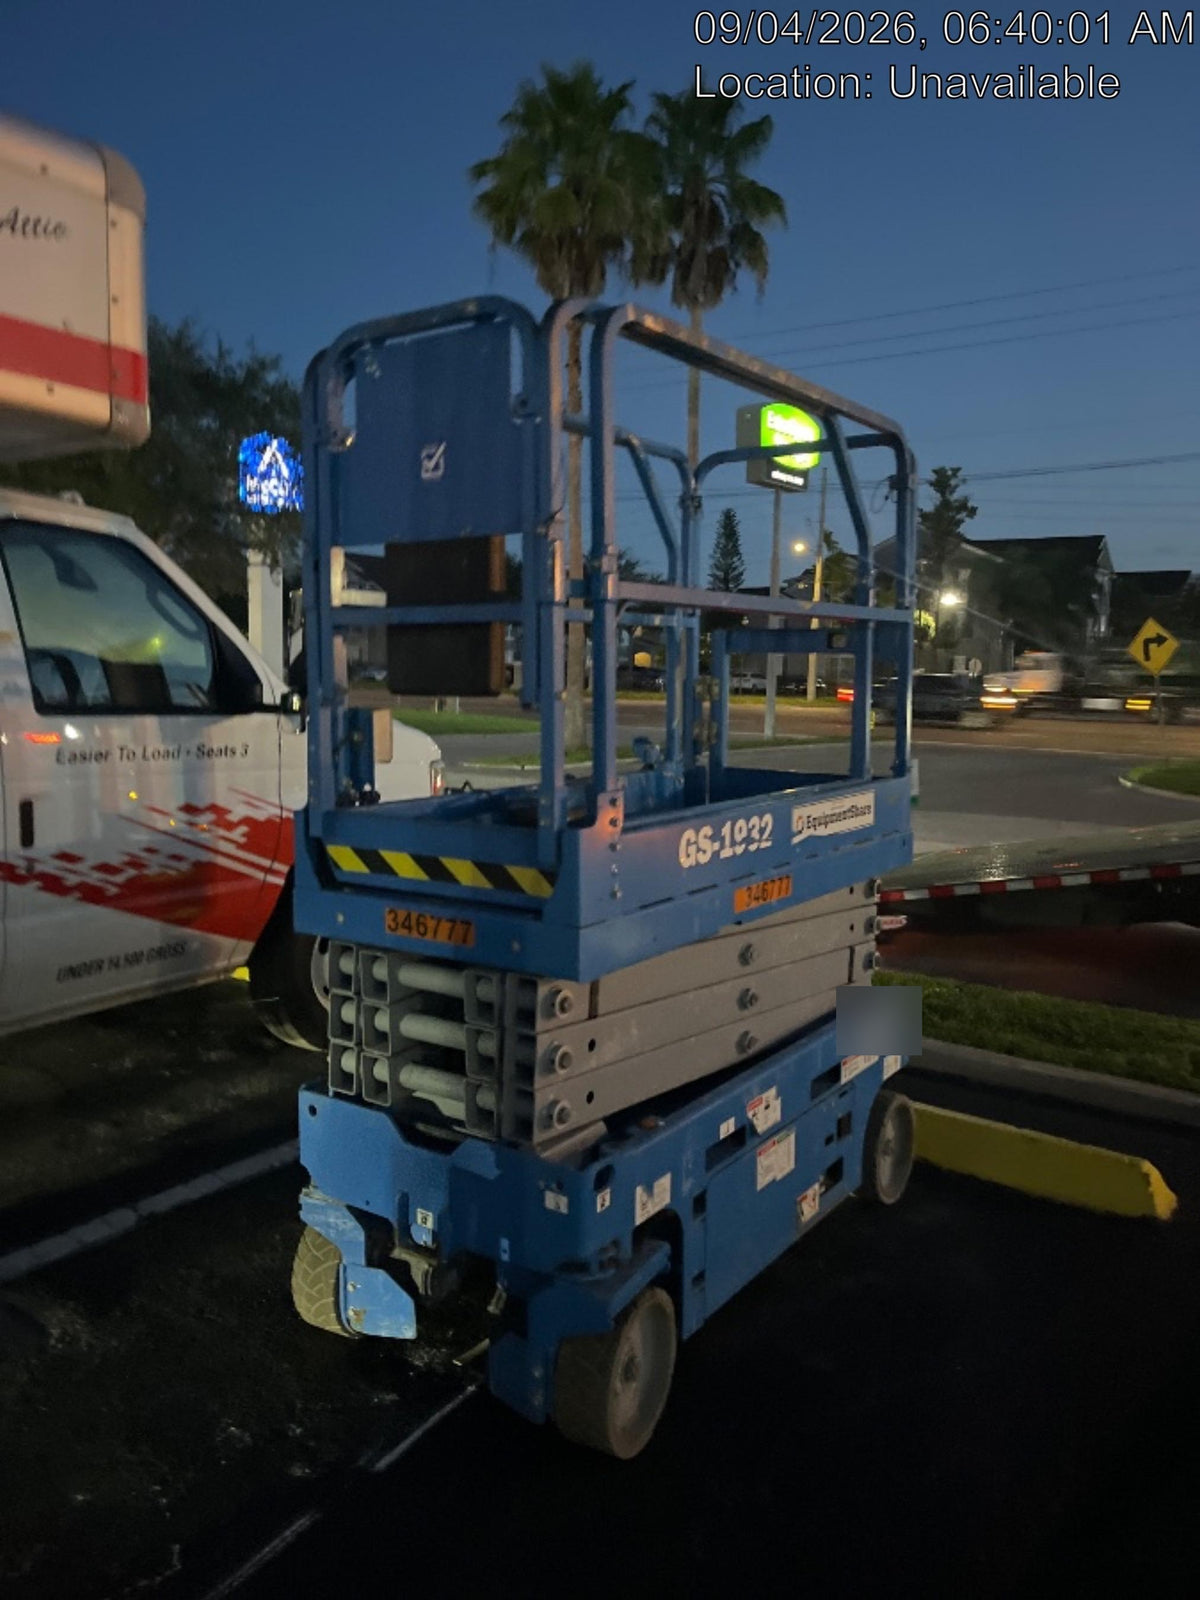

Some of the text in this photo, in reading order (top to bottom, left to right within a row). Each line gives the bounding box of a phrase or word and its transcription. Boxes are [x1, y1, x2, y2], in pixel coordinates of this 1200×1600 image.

[55, 742, 250, 766] Easier To Load Seats 3
[678, 812, 774, 869] GS-1932
[744, 875, 791, 908] 346777
[386, 908, 473, 945] 346777
